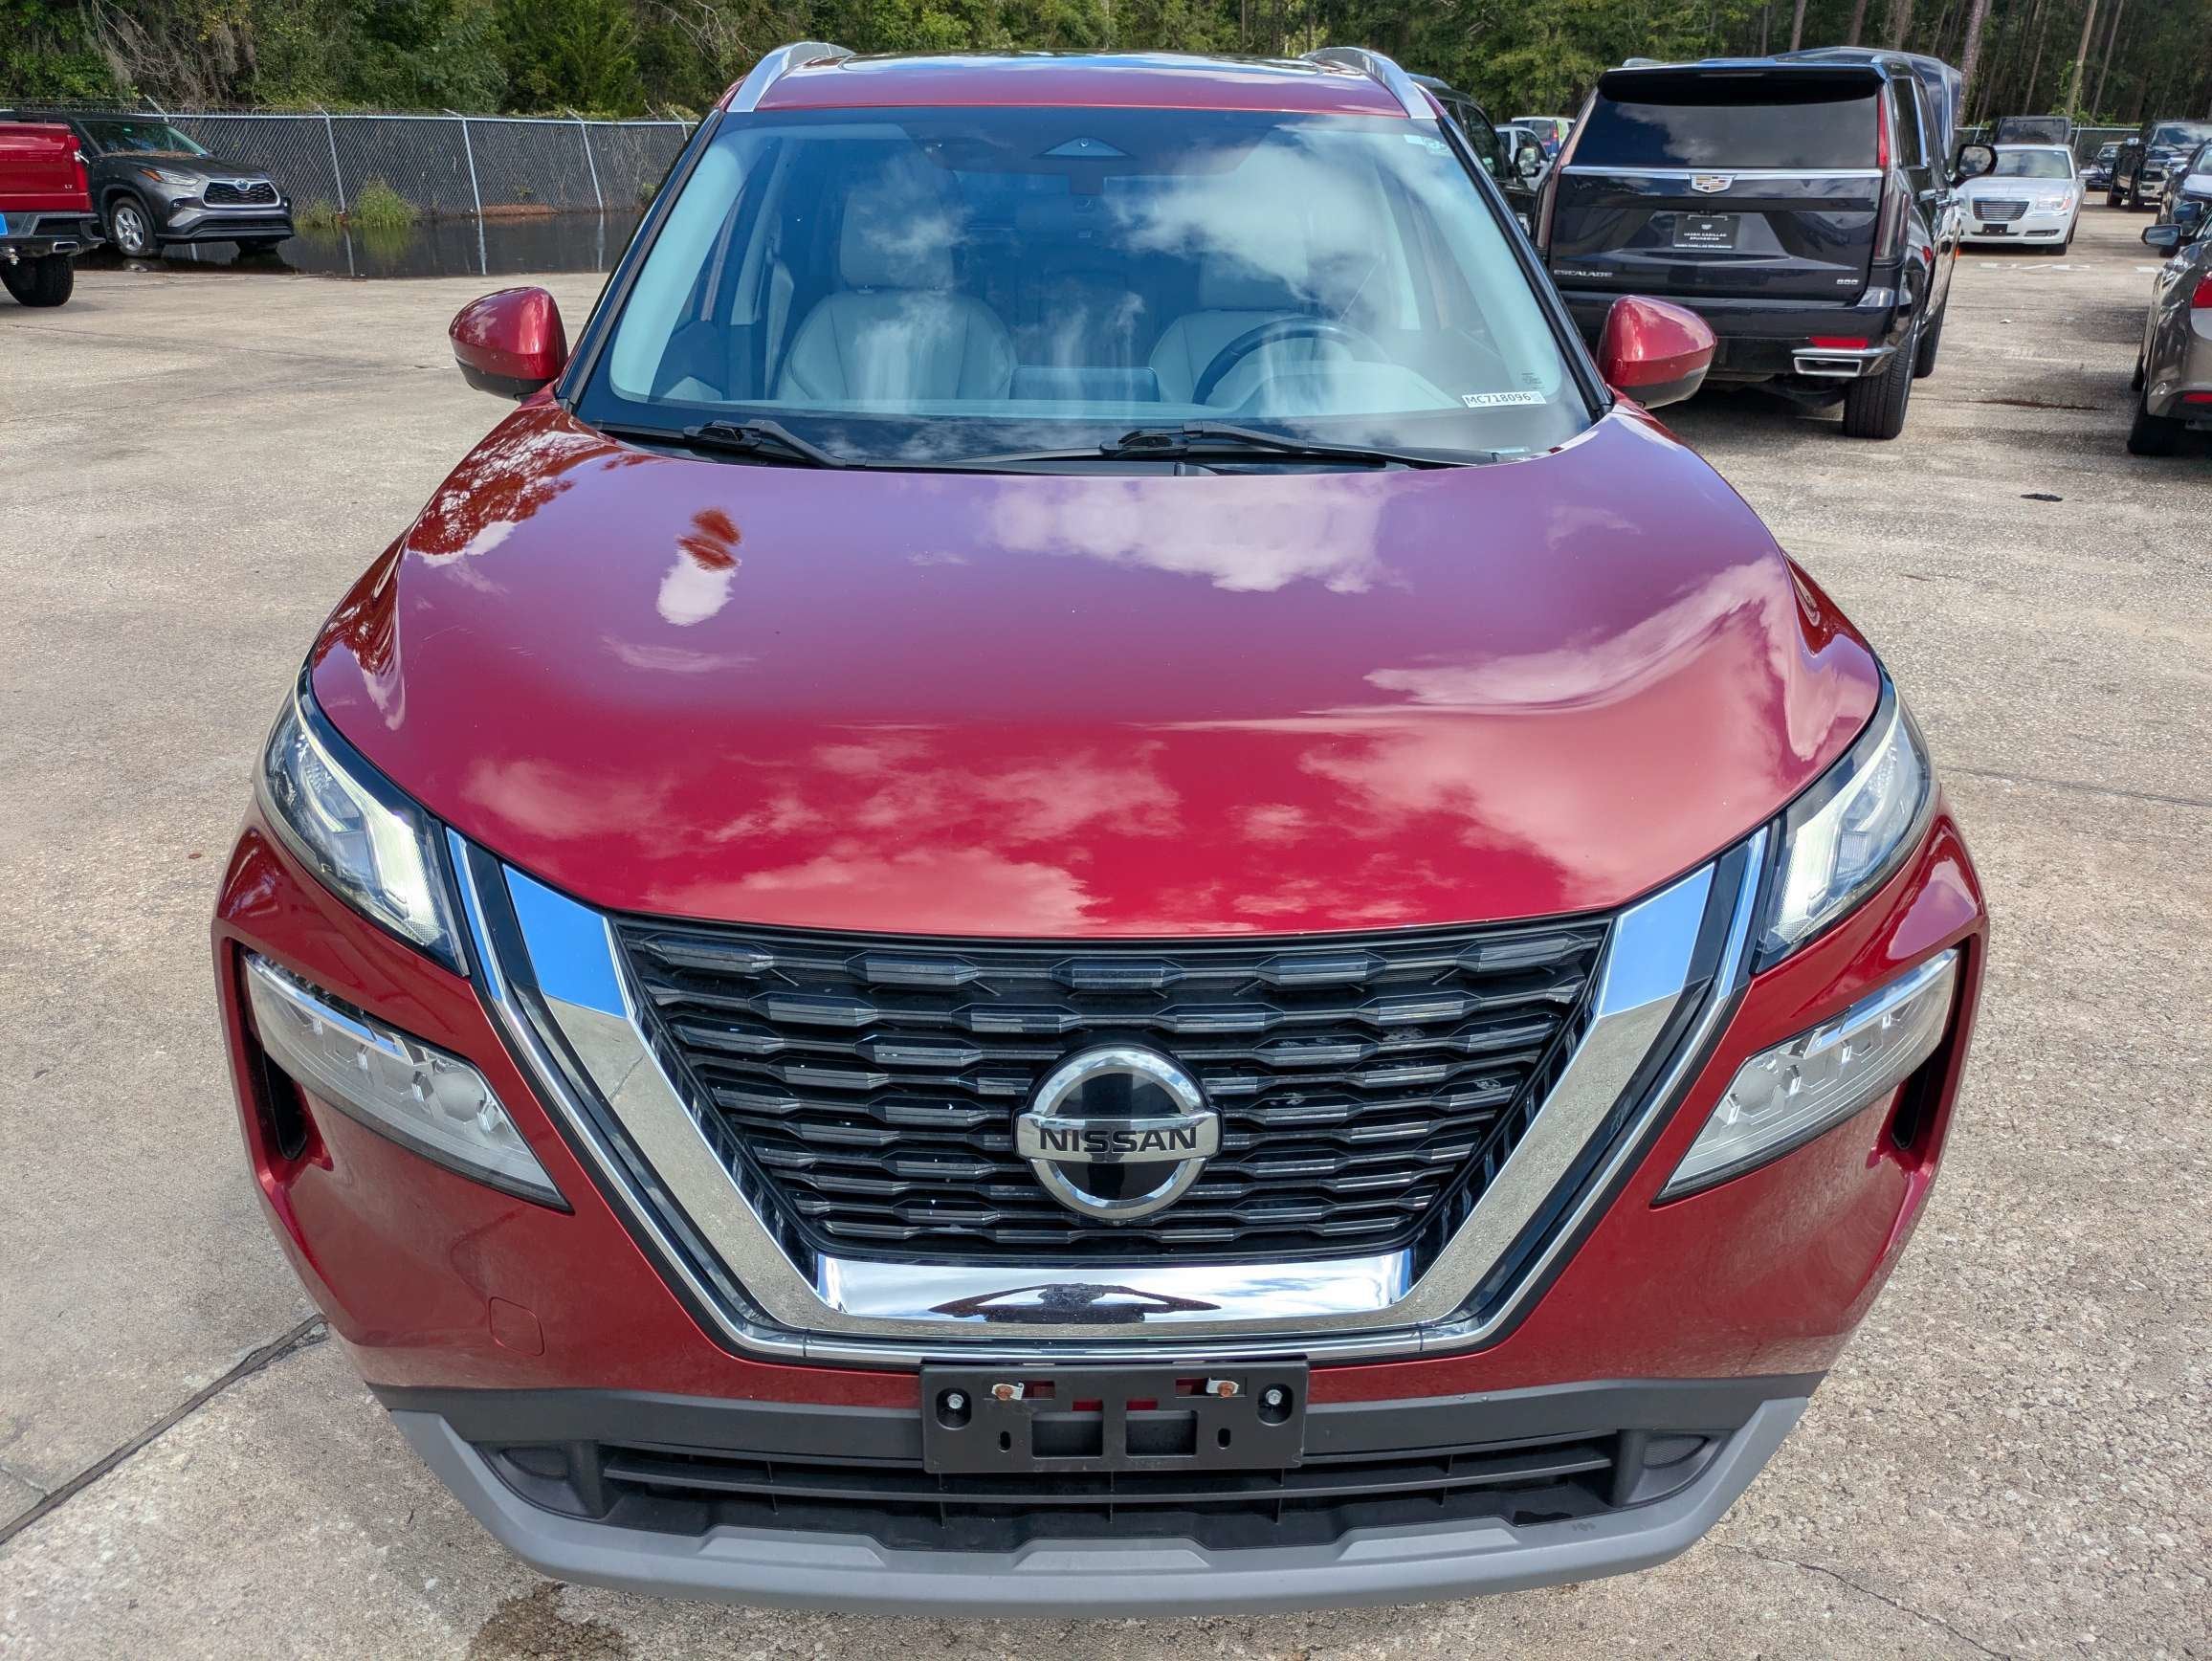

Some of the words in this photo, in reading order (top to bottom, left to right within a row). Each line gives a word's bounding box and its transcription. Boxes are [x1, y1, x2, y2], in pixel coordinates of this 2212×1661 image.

[1554, 269, 1613, 277] ESCALADE
[1465, 392, 1532, 405] MC718096
[1039, 1128, 1198, 1154] NISSAN
